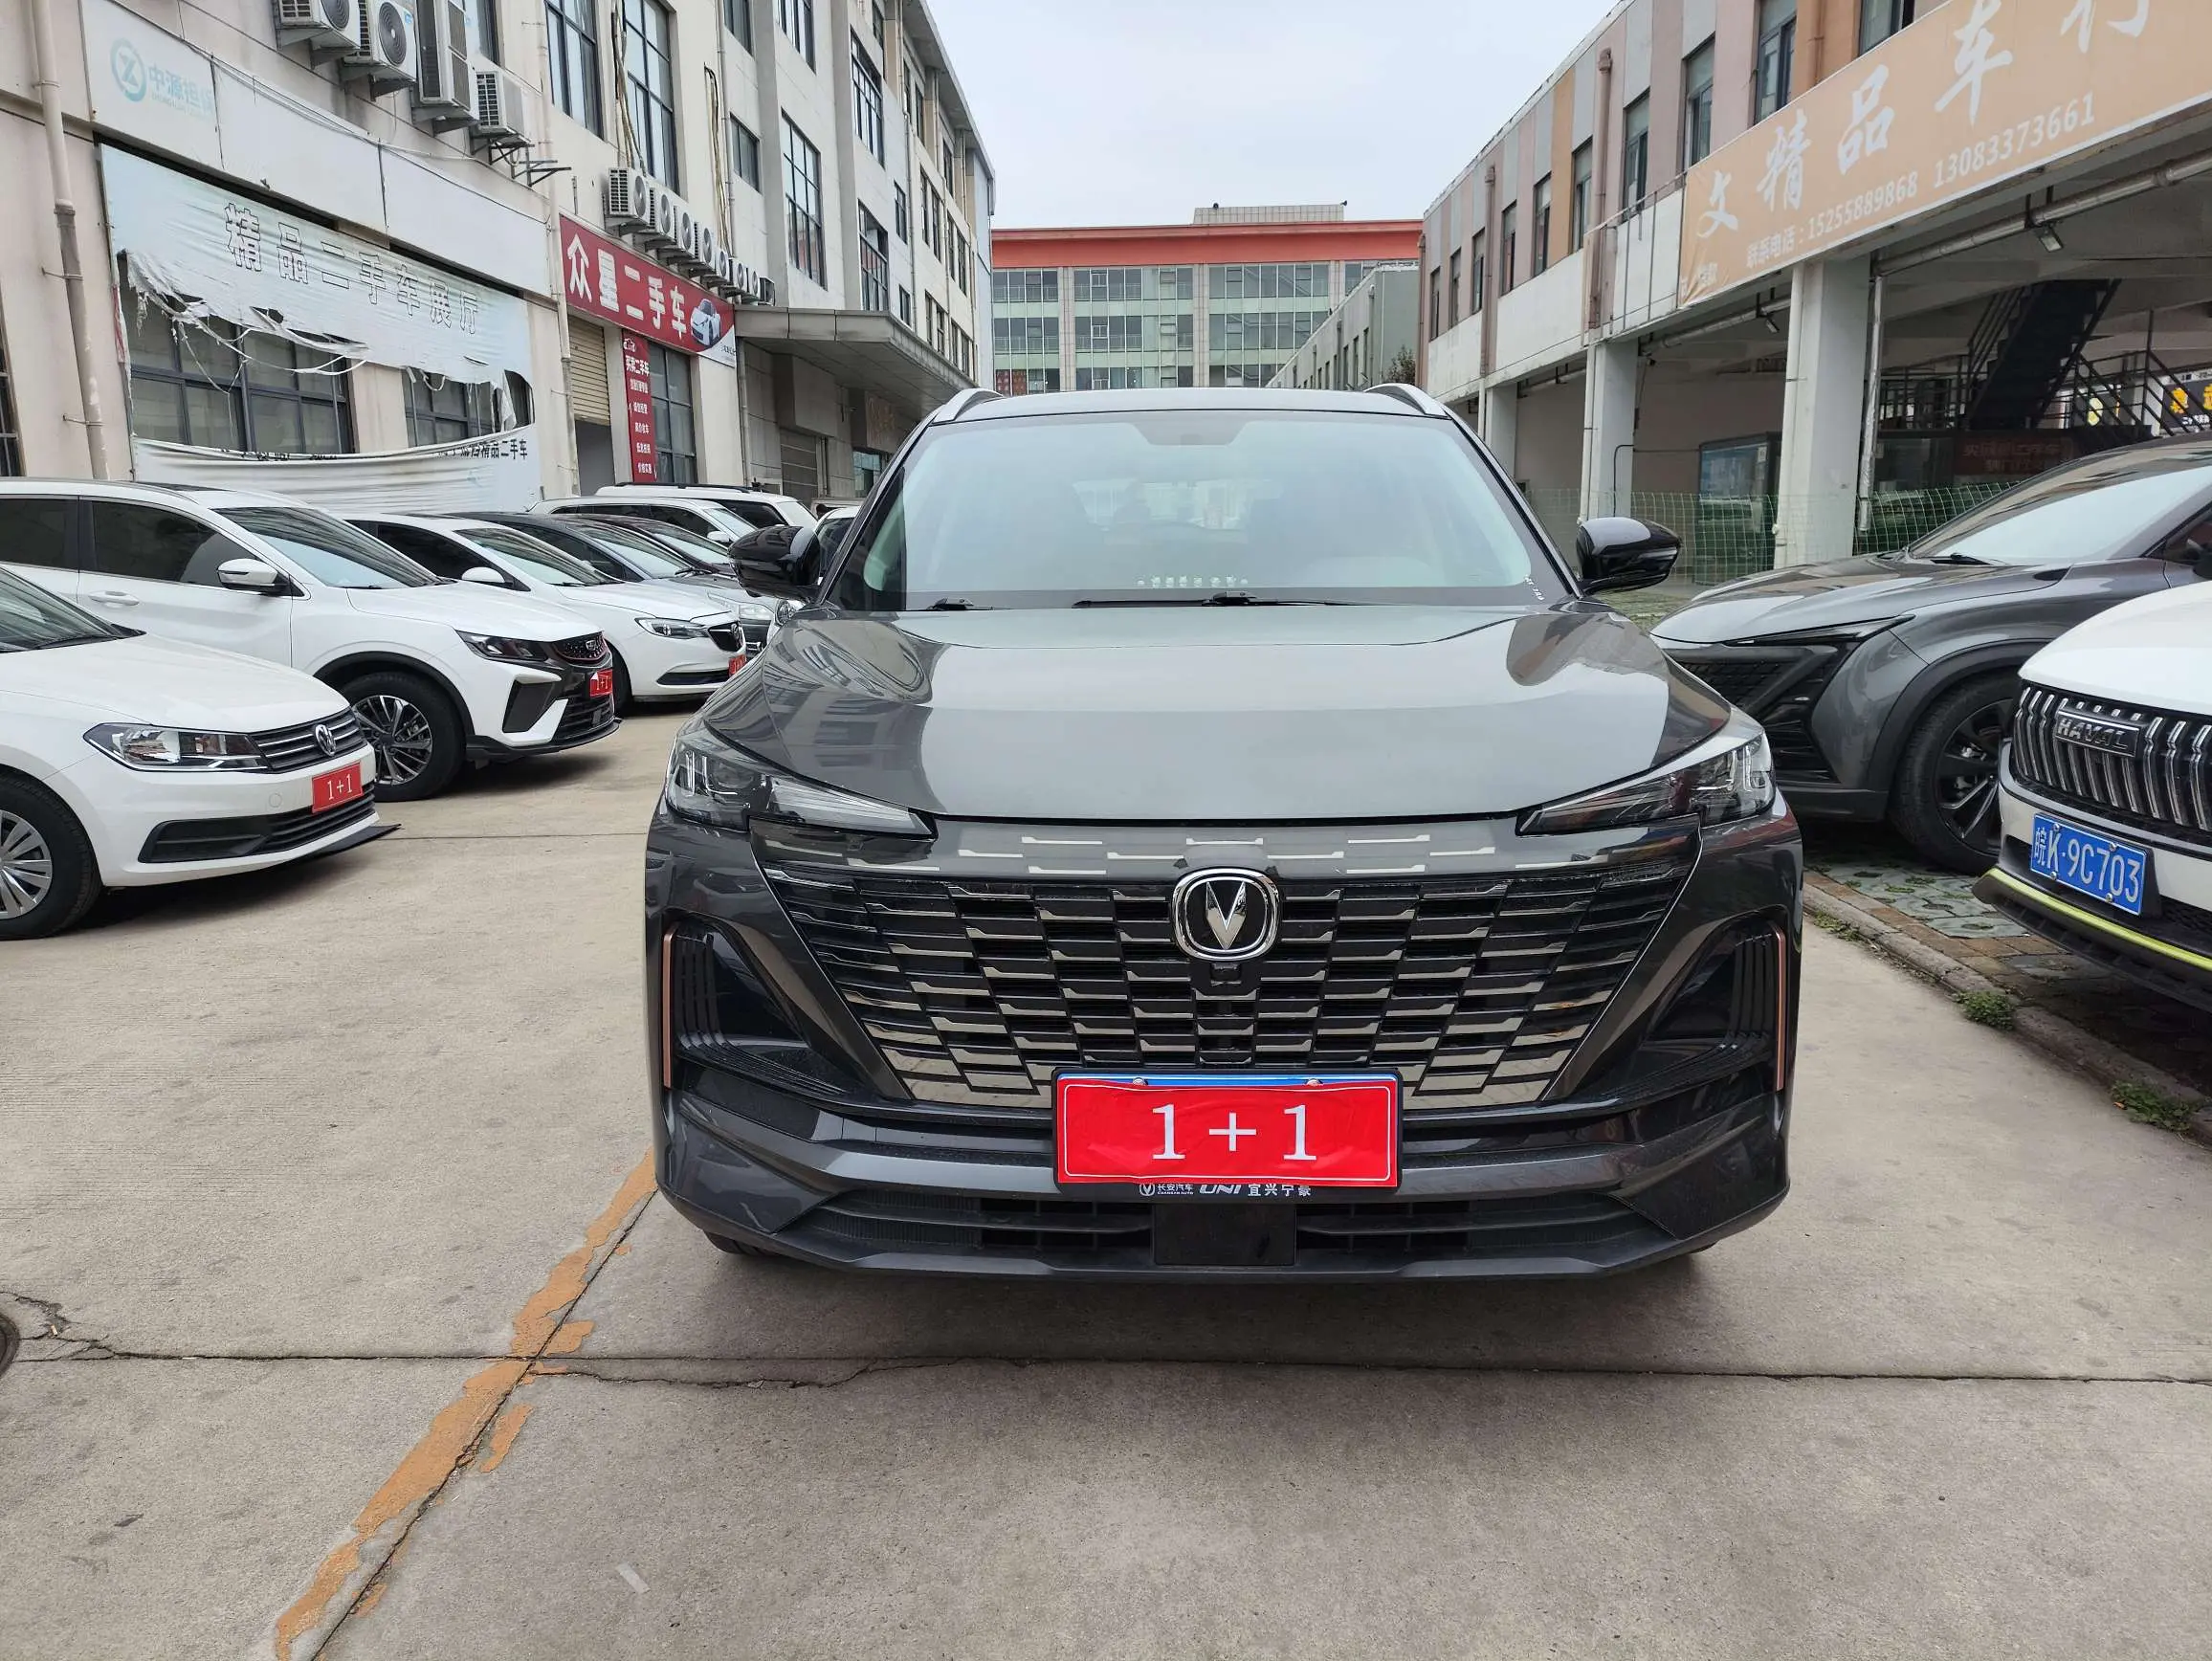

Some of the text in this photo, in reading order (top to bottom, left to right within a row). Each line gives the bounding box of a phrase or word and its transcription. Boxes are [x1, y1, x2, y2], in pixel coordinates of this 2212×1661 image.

[1934, 90, 2095, 188] 13083373661
[225, 203, 479, 335] 精品二手车展厅
[567, 233, 687, 339] 众星二手车
[2058, 718, 2129, 750] HAVAL
[327, 773, 353, 800] 1+1
[1157, 1184, 1311, 1197] 长安汽车 UNI 宜兴宁豪
